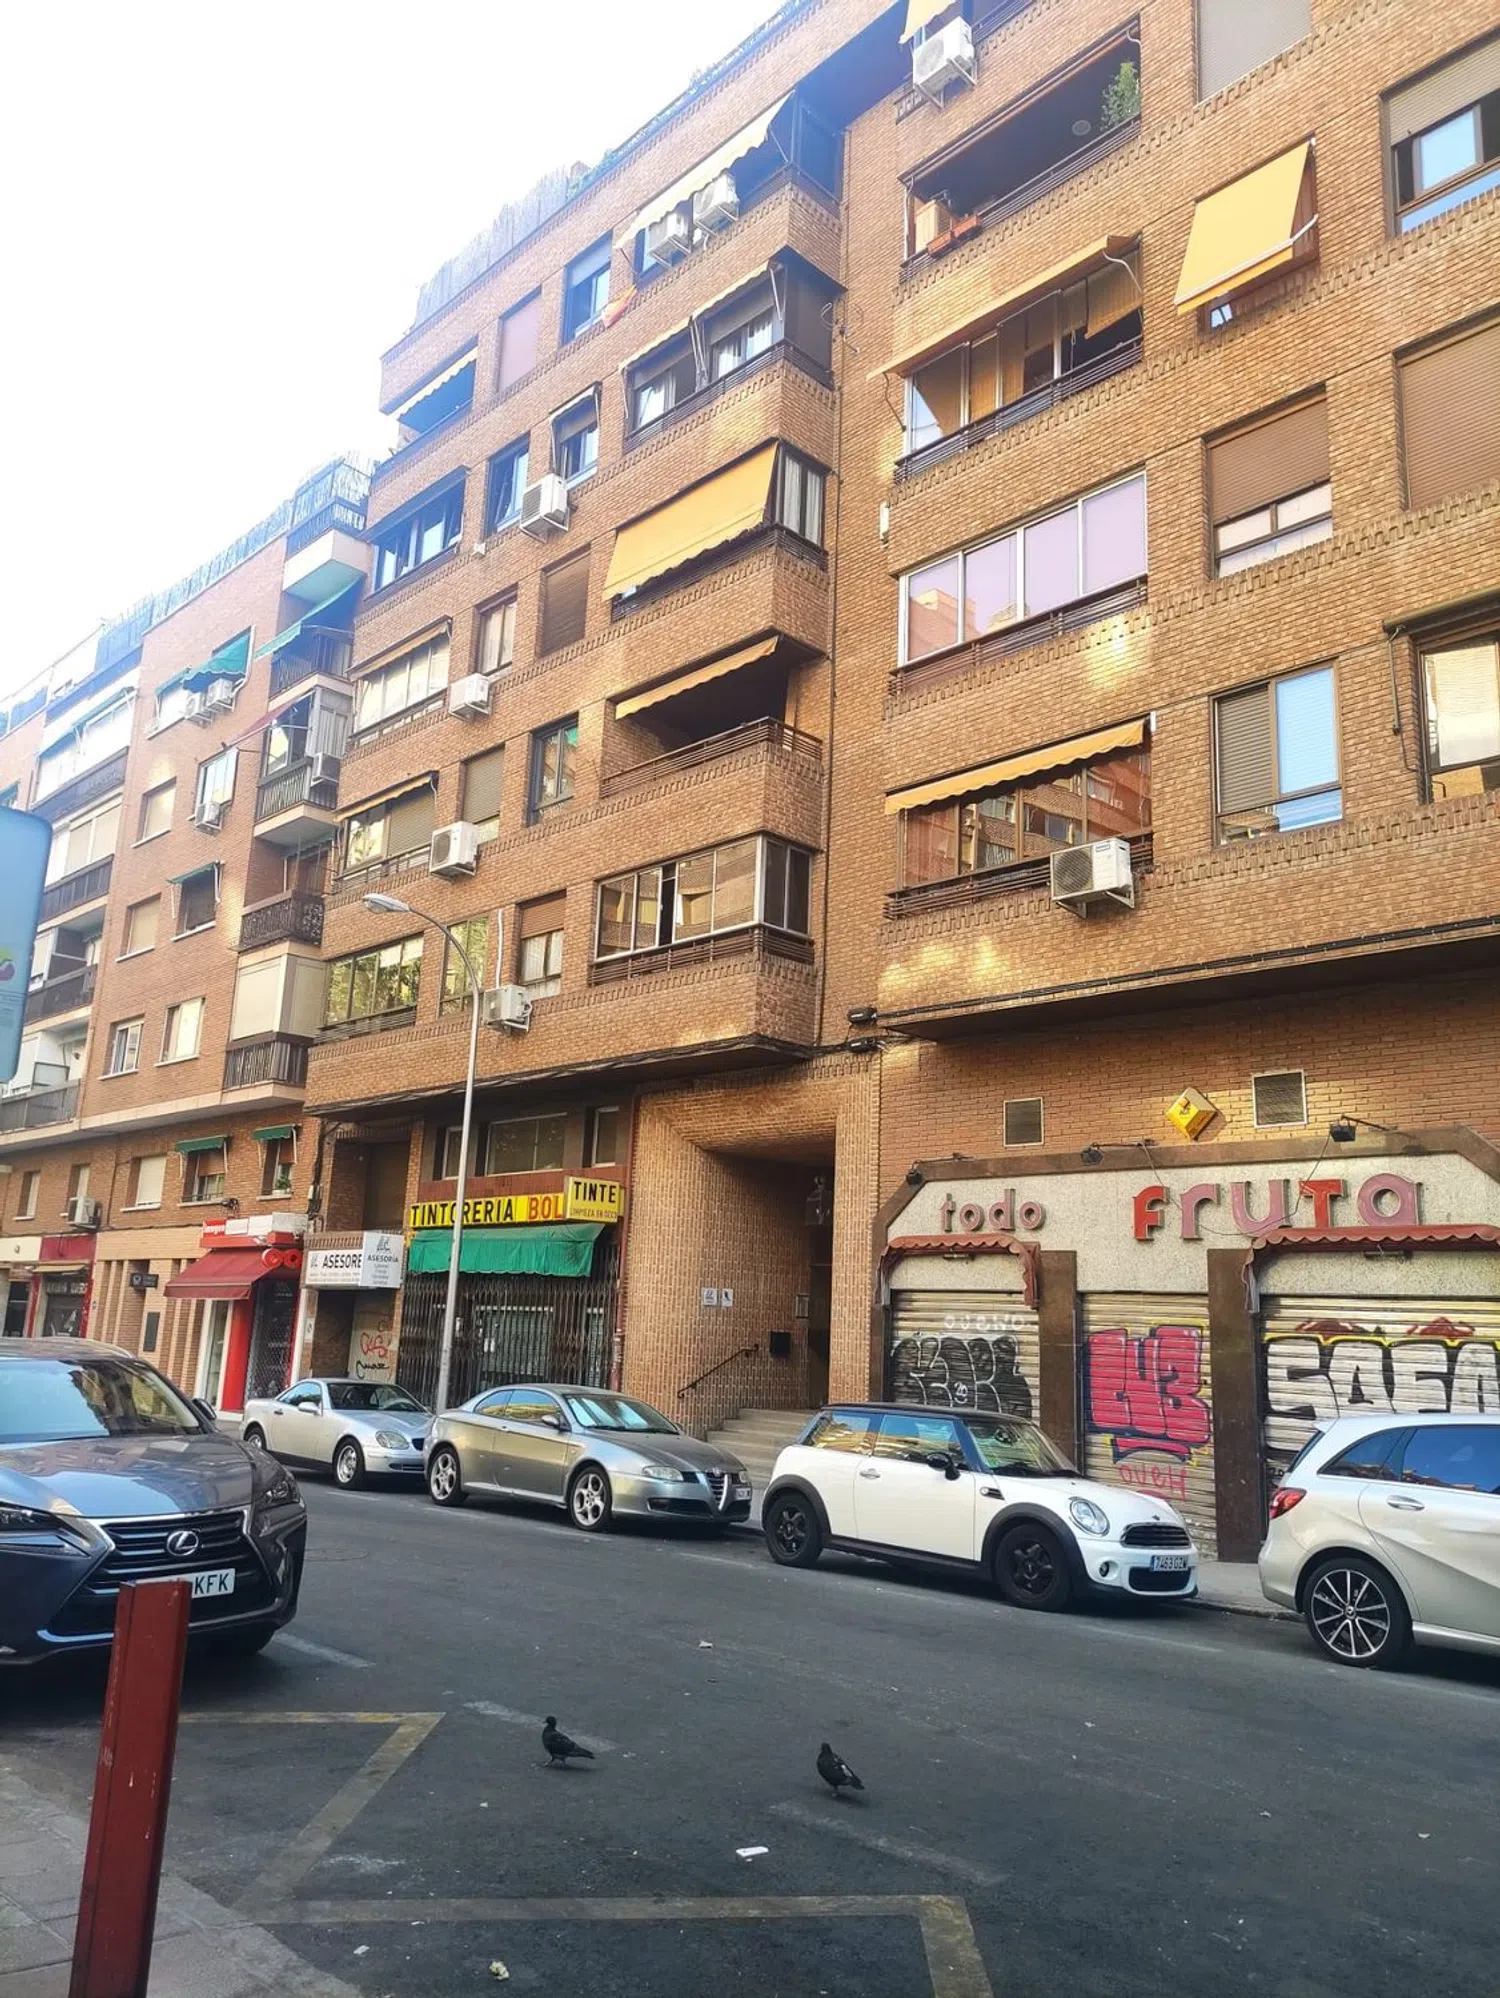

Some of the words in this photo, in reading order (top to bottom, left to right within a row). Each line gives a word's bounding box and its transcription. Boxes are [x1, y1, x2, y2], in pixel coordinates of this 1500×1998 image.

[574, 1181, 617, 1203] TINTE
[939, 1188, 1046, 1232] todo
[194, 1573, 230, 1595] KFK
